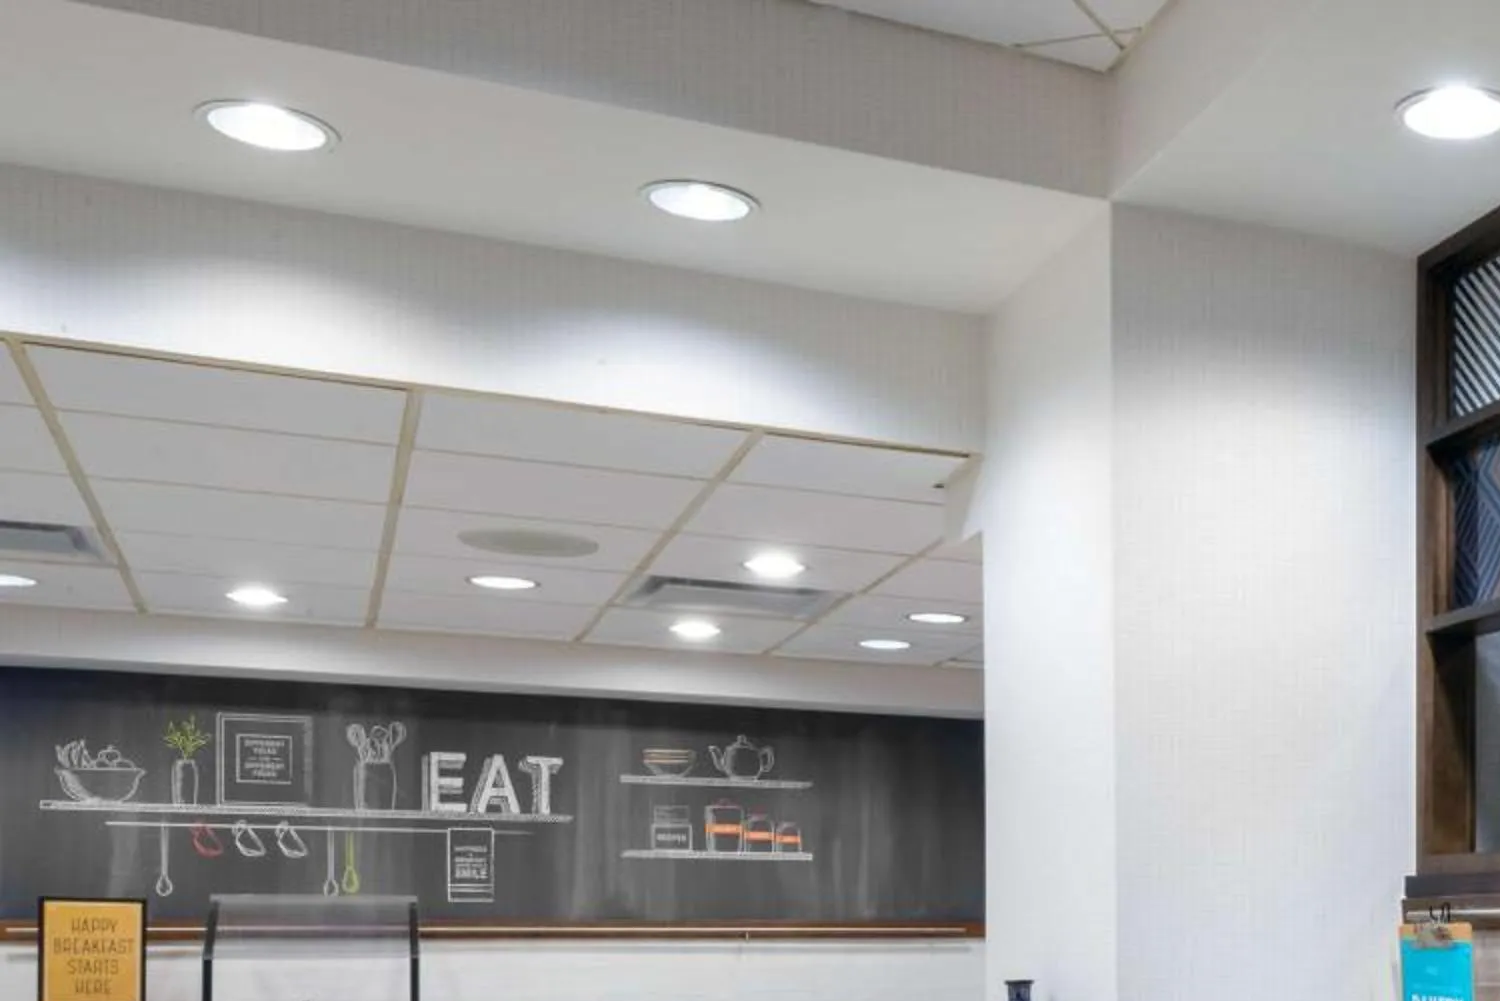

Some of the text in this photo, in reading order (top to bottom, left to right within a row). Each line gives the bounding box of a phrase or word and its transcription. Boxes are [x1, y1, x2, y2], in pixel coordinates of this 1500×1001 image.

[421, 751, 564, 815] EAT
[71, 917, 119, 934] HAPPY
[53, 937, 135, 955] BREAKFAST
